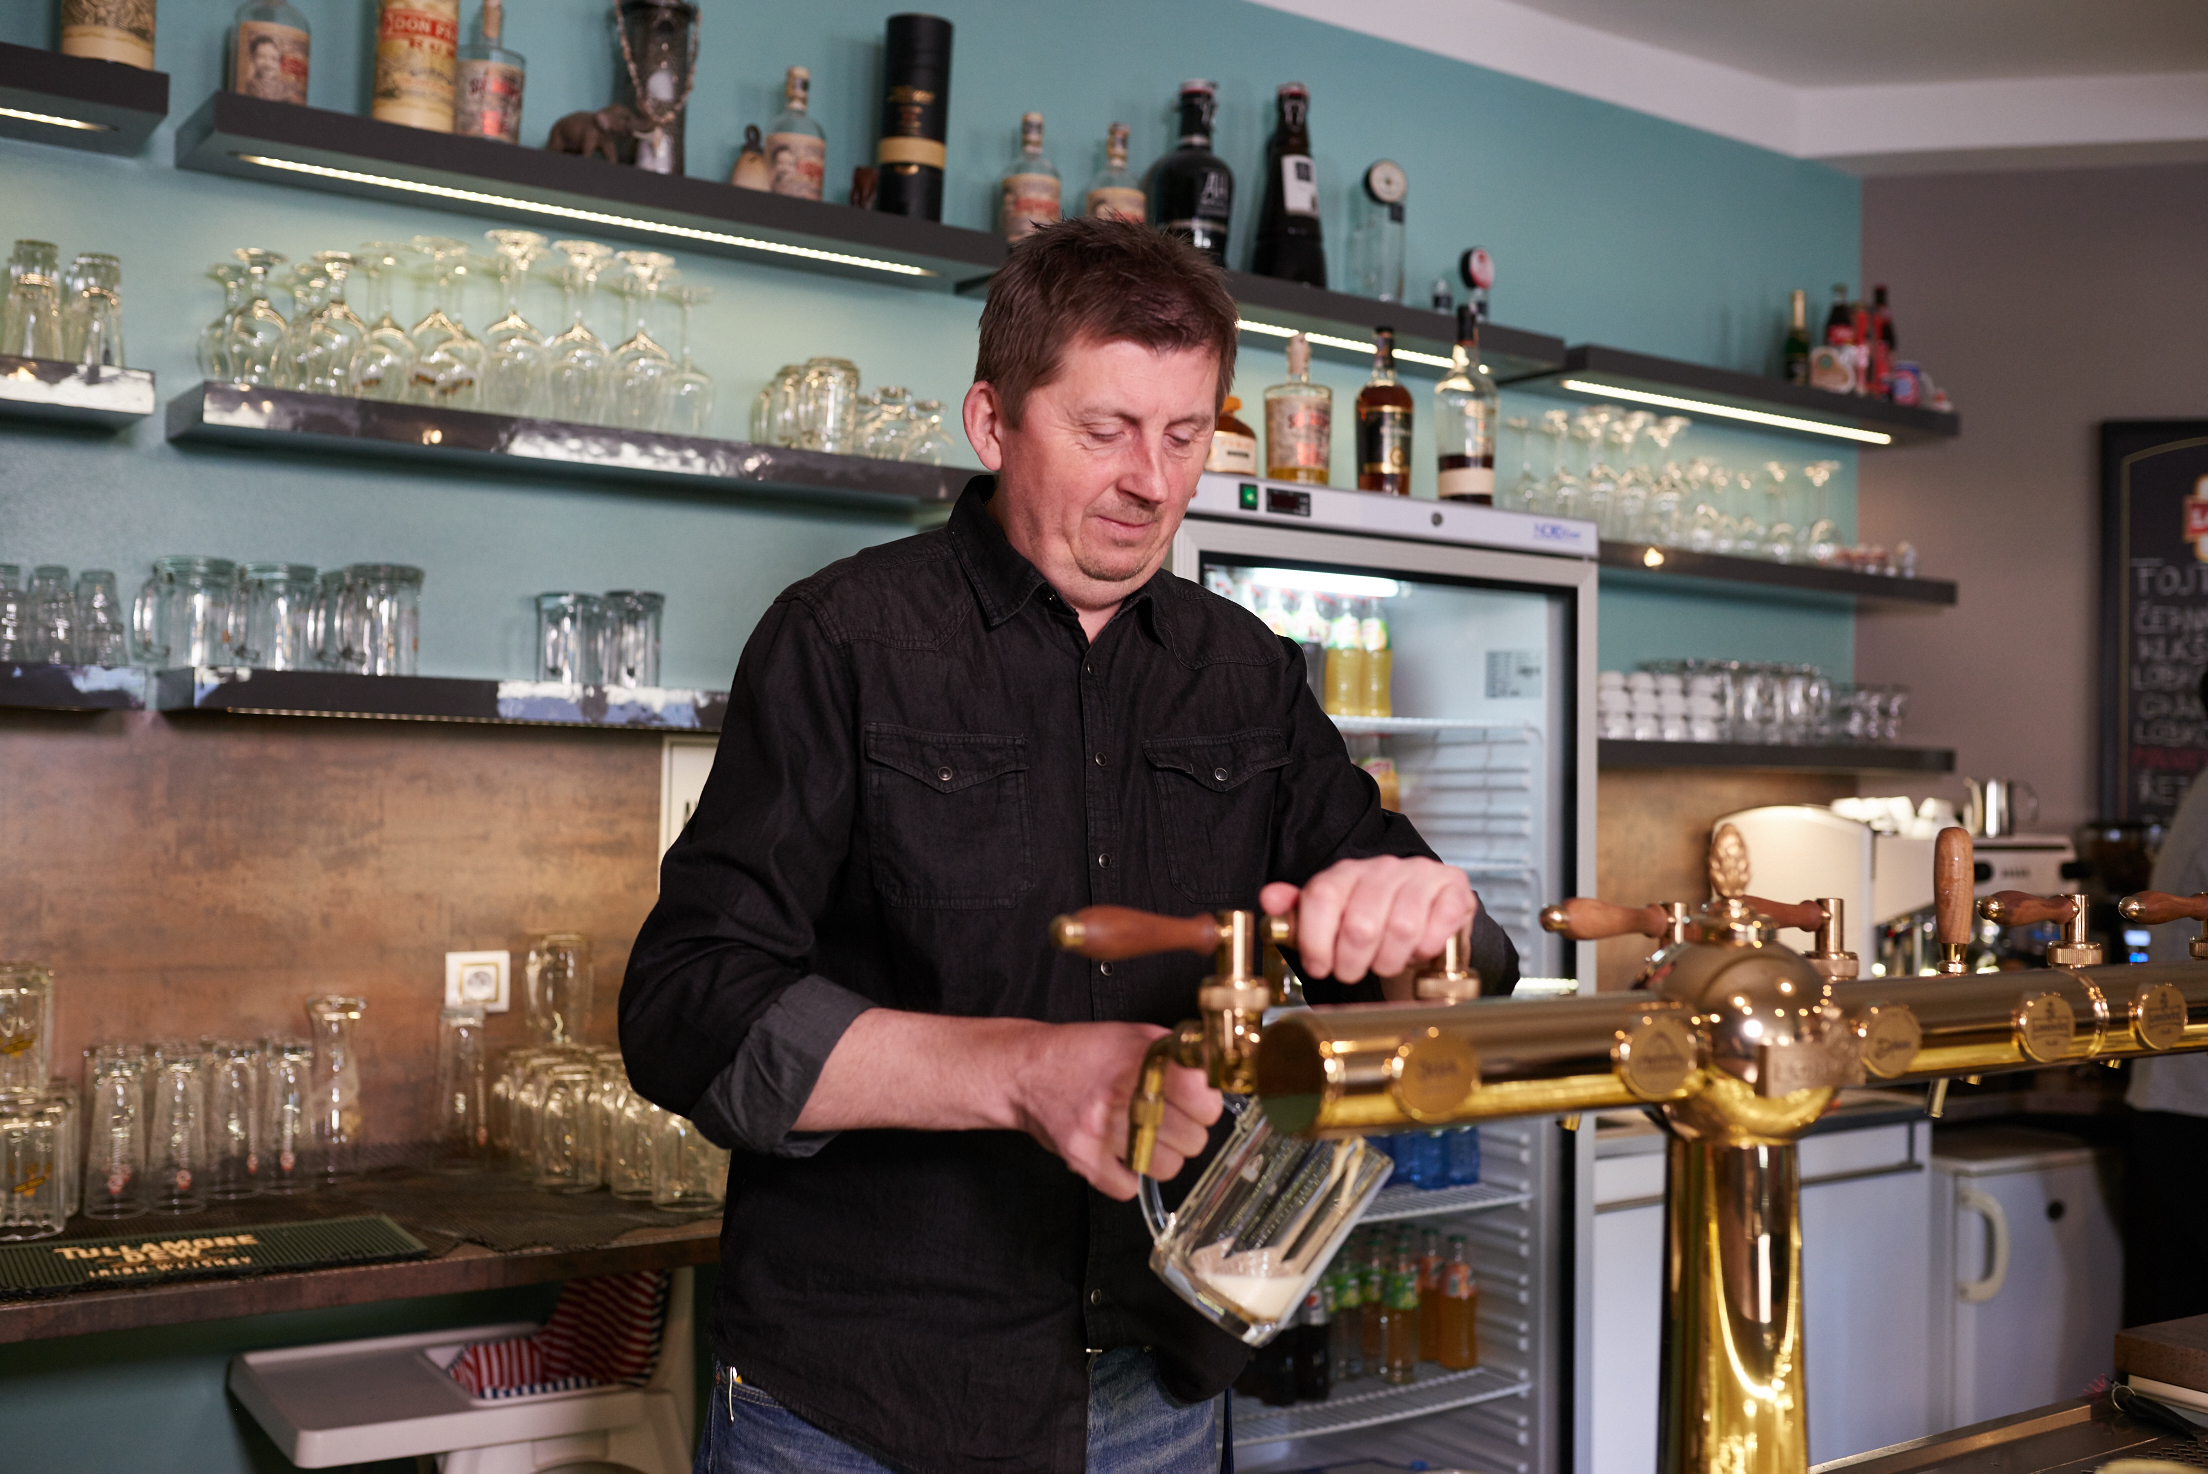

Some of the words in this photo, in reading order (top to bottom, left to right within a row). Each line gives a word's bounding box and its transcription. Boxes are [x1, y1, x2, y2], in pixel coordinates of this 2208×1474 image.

[394, 16, 431, 33] DON
[53, 1234, 259, 1260] TULLAMORE
[123, 1247, 201, 1263] DEW
[89, 1266, 148, 1278] IRISH
[156, 1256, 250, 1271] WHISKEY
